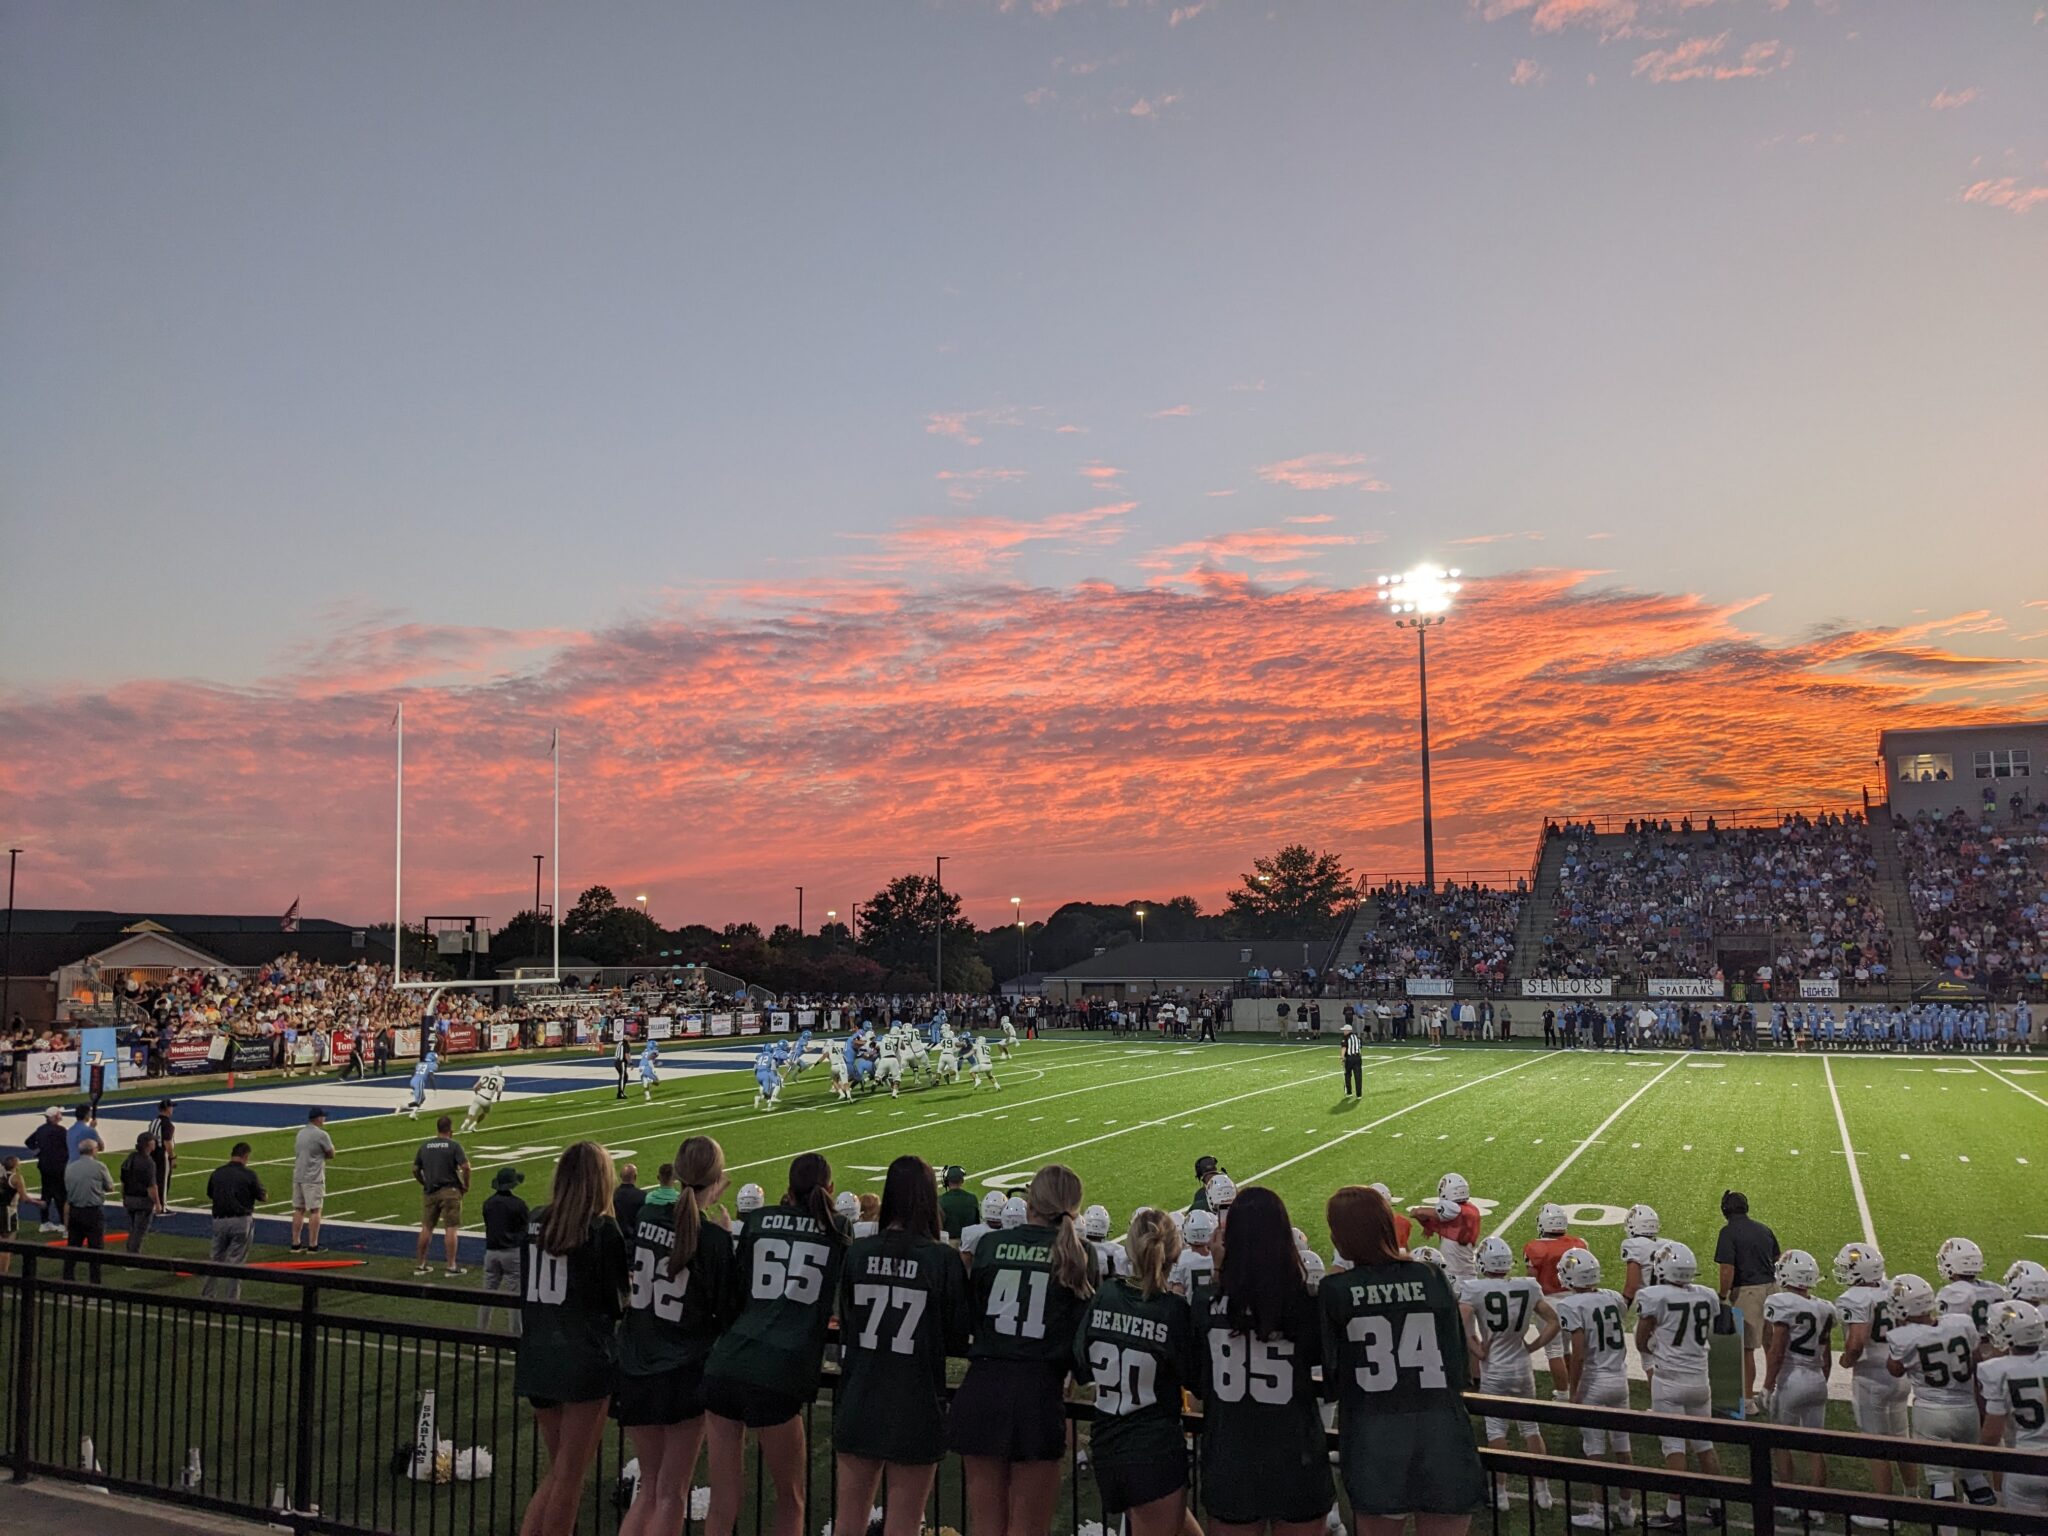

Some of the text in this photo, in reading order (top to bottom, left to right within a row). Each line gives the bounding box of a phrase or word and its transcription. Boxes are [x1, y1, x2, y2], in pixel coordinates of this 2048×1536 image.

[1445, 980, 1453, 994] 12
[1528, 979, 1603, 994] SENIORS
[1658, 985, 1715, 995] SPARTANS
[481, 1076, 498, 1091] 26
[526, 1243, 569, 1306] 10
[751, 1237, 831, 1305] 65
[995, 1243, 1053, 1263] COME
[630, 1246, 691, 1323] 32
[985, 1268, 1050, 1340] 41
[1350, 1281, 1427, 1306] PAYNE
[853, 1283, 928, 1355] 77
[1091, 1308, 1169, 1343] BEAVERS
[1484, 1289, 1530, 1333] 97
[1593, 1304, 1624, 1352] 13
[1667, 1300, 1711, 1347] 78
[1088, 1340, 1157, 1416] 20
[1207, 1327, 1295, 1405] 85
[1346, 1312, 1450, 1393] 34
[1917, 1336, 1971, 1388] 53
[2007, 1376, 2048, 1430] 5
[416, 1405, 431, 1464] SPARTANS
